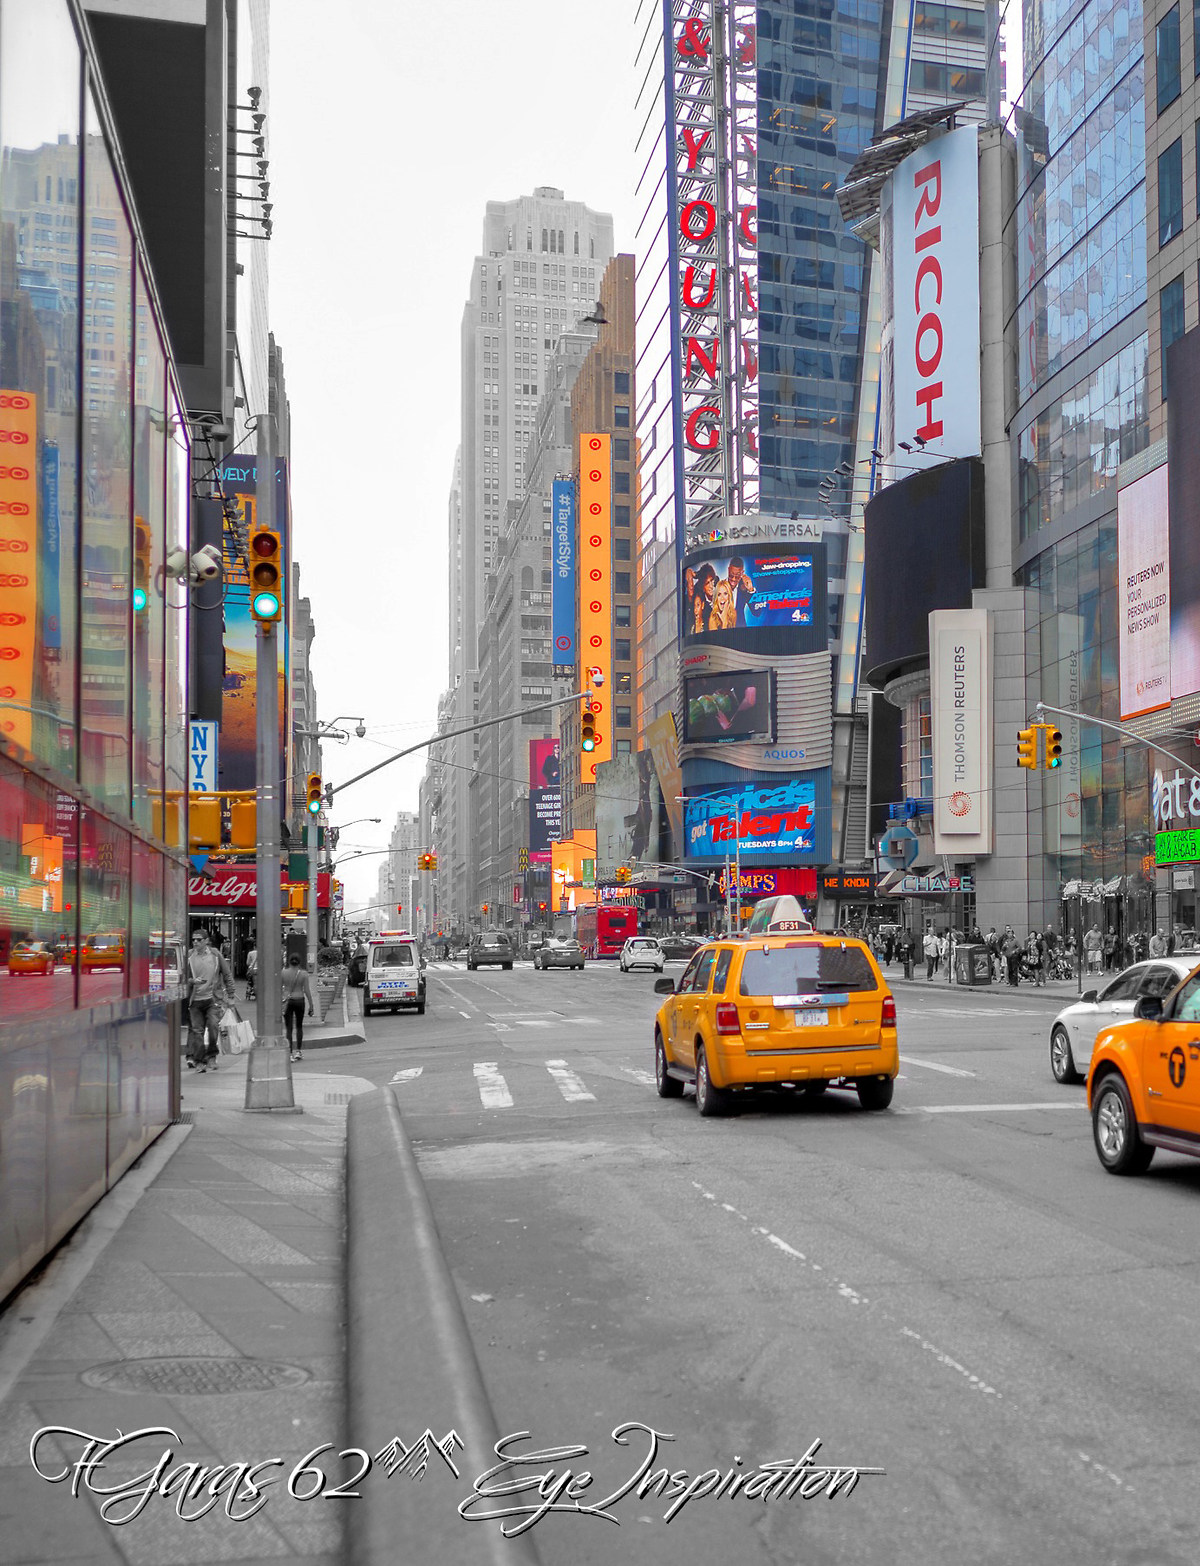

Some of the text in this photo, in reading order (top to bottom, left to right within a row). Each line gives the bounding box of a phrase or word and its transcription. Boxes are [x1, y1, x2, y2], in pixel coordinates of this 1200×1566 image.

[677, 17, 711, 57] &
[679, 129, 721, 450] YOUNG
[914, 159, 944, 445] RICOH
[556, 494, 571, 578] #TargetStyle
[1127, 561, 1165, 588] REUTERS NOW
[1127, 588, 1142, 603] YOUR
[1127, 593, 1167, 619] PERSONALIZED
[791, 609, 800, 619] 4
[1127, 612, 1159, 635] NEWS SHOW
[684, 655, 707, 666] SHARP
[1145, 677, 1162, 691] REUTERS
[954, 646, 965, 783] THOMSON REUTERS
[764, 750, 805, 760] AQUOS
[691, 805, 813, 843] got Talent
[737, 840, 777, 849] TUESDAYS
[824, 877, 870, 888] WE KNOW
[779, 921, 799, 931] 8F31
